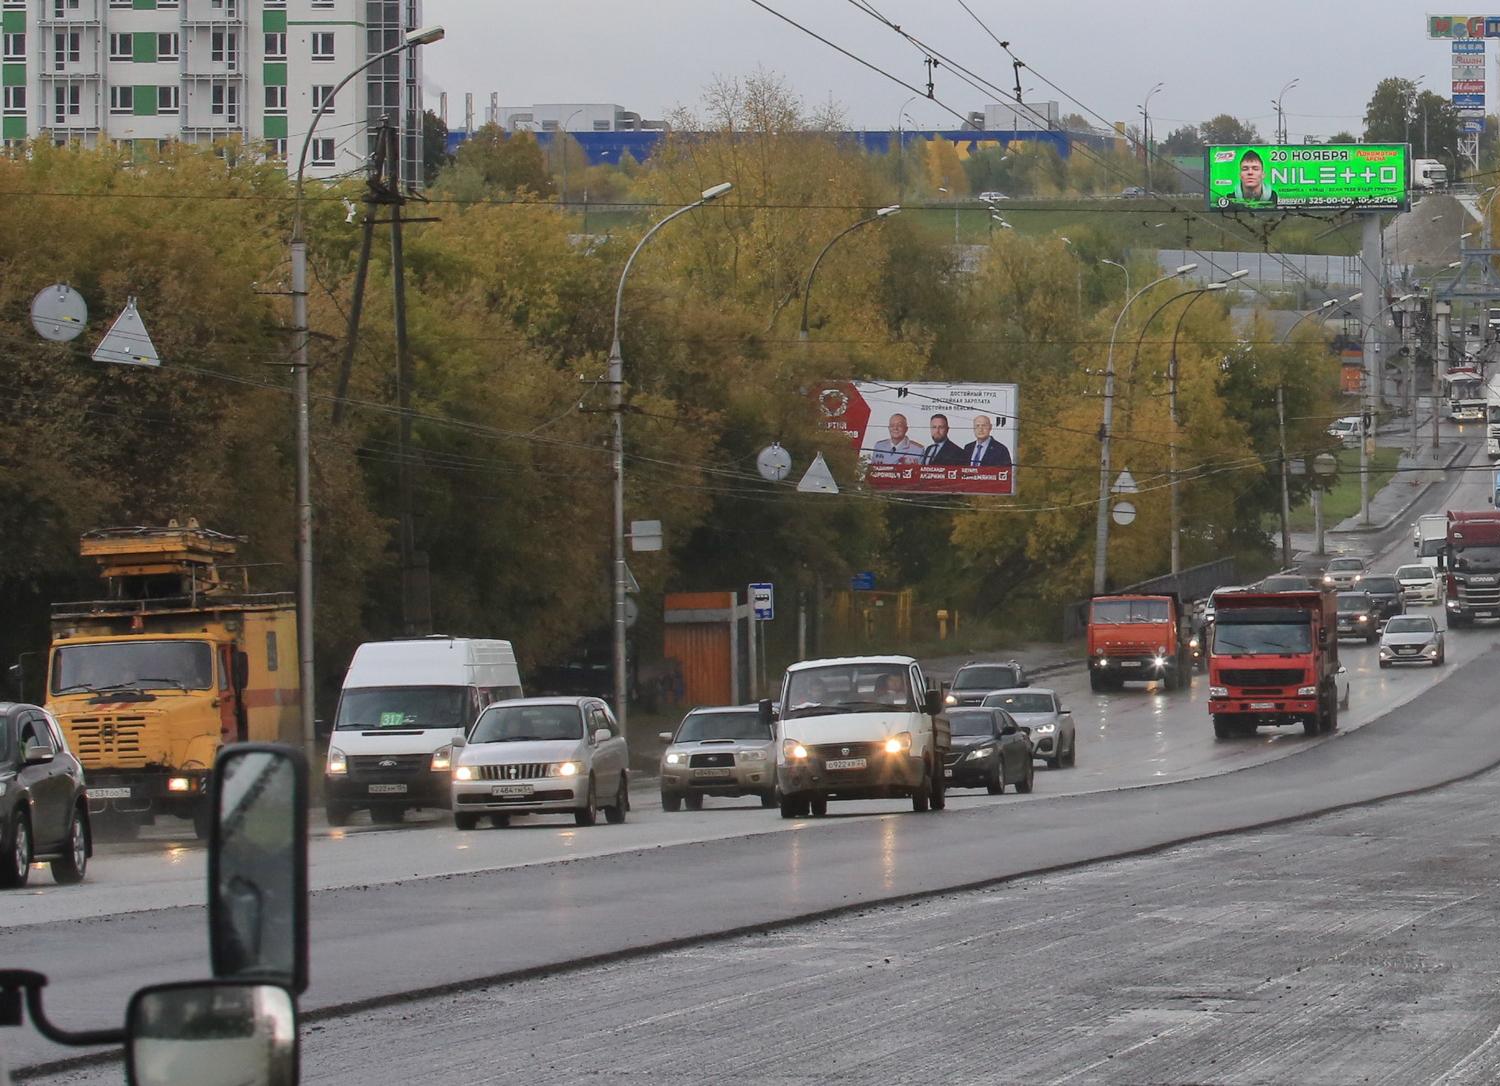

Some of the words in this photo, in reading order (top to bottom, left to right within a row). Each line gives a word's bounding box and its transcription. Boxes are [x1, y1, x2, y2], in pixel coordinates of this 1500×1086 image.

[1271, 151, 1287, 161] 20
[1292, 151, 1349, 161] НОЯБРЯ
[382, 714, 402, 726] 317
